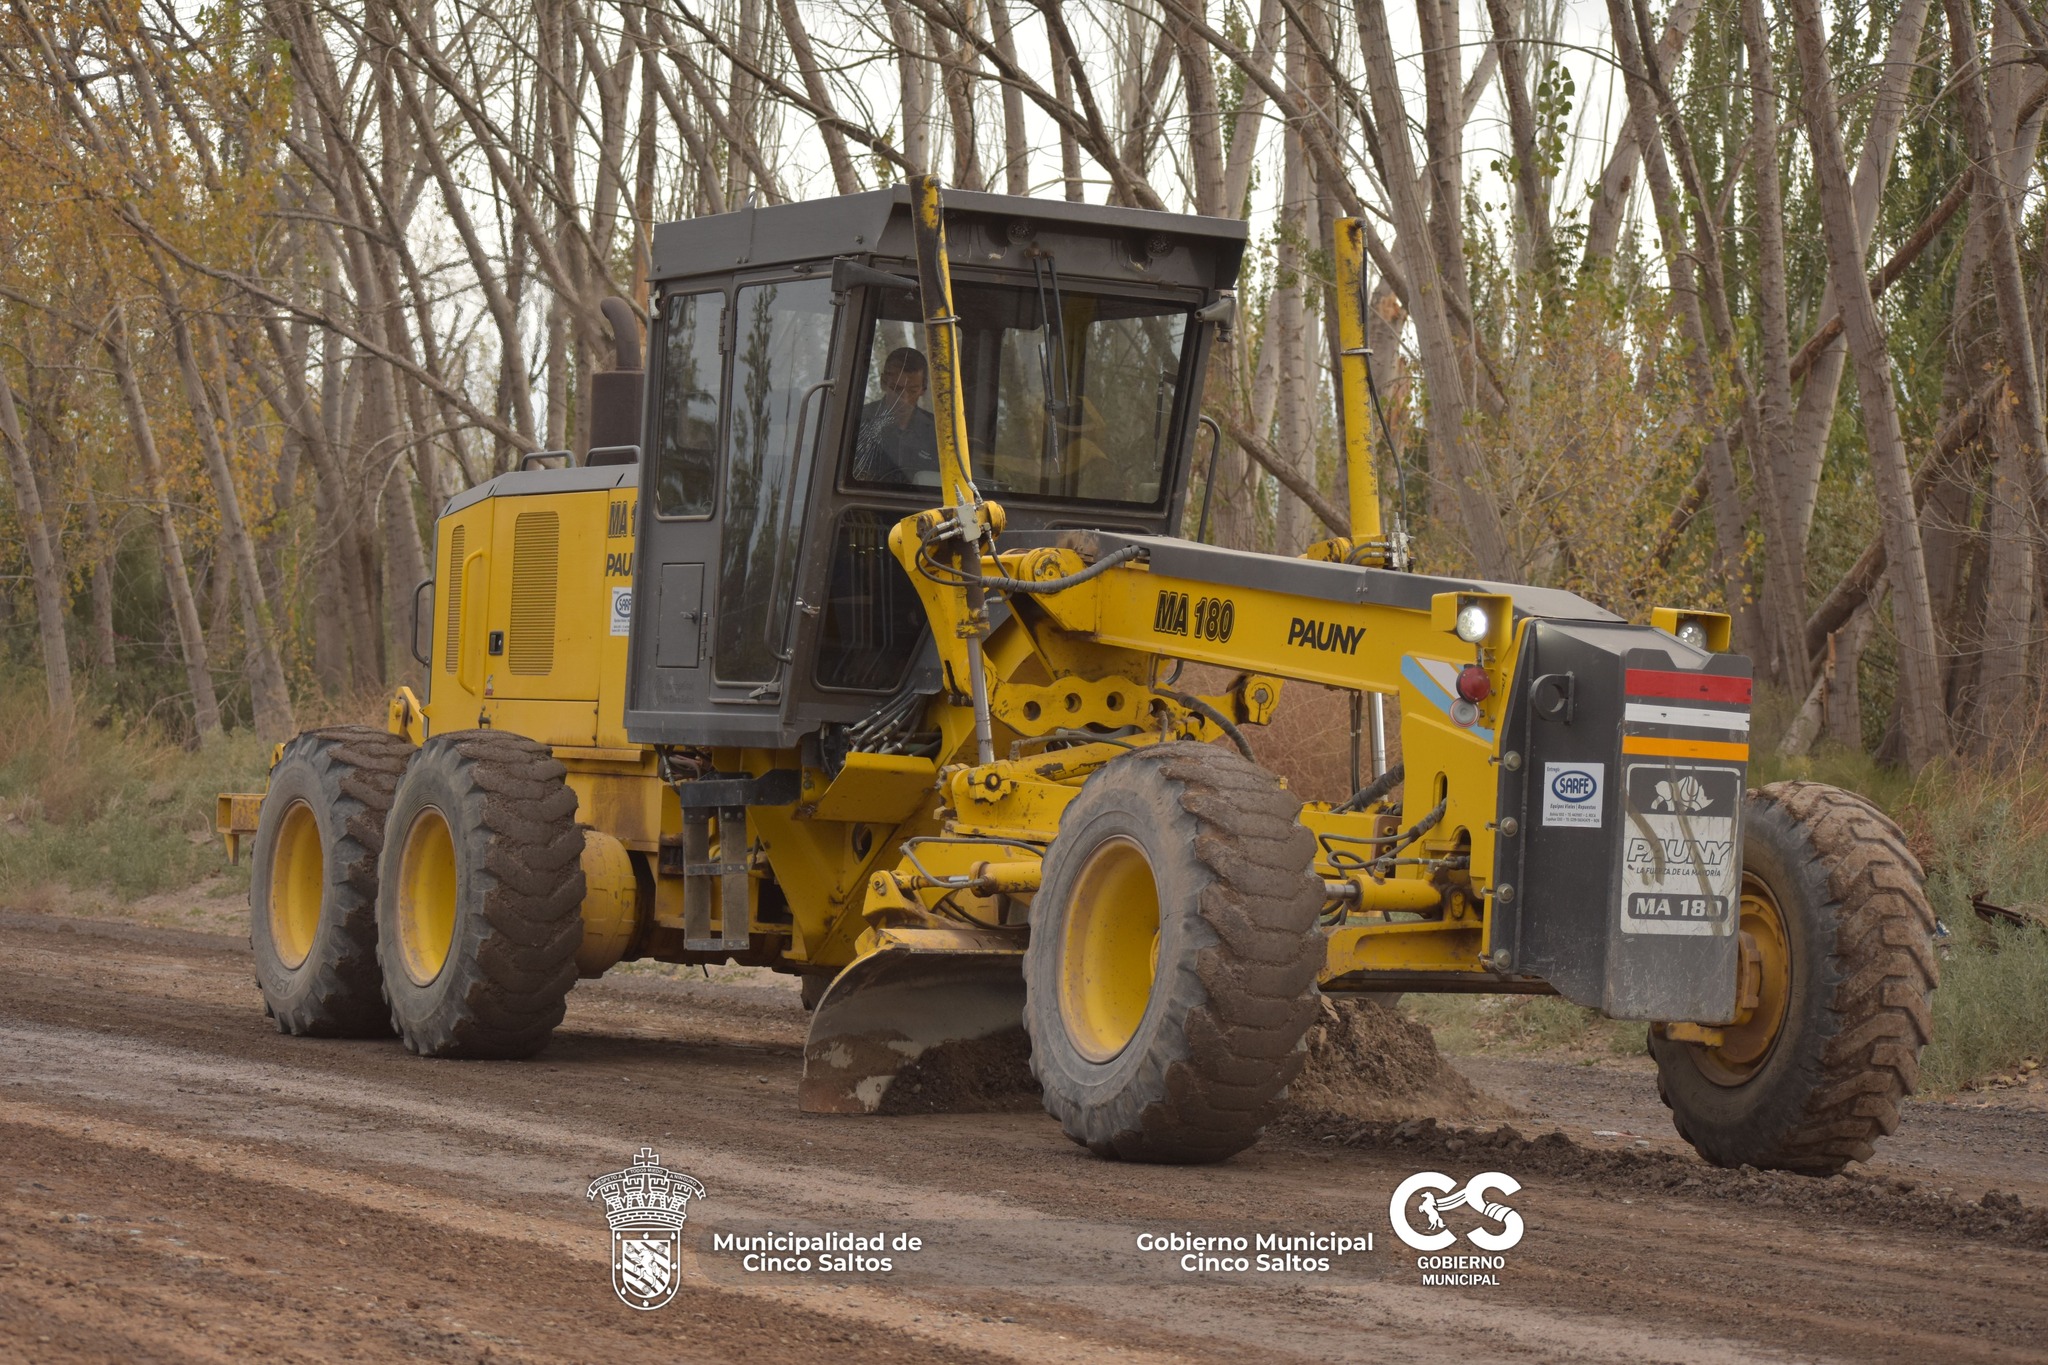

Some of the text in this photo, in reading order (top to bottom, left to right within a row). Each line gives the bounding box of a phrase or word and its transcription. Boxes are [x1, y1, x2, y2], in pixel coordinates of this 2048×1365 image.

[608, 500, 628, 538] MA
[605, 553, 633, 576] PAU
[1154, 590, 1235, 643] MA 180
[1288, 617, 1367, 655] PAUNY
[1560, 777, 1589, 794] SARFE
[1626, 838, 1734, 865] PAUNY
[1672, 868, 1681, 876] DE
[1682, 868, 1690, 876] LA
[1635, 898, 1671, 915] MA
